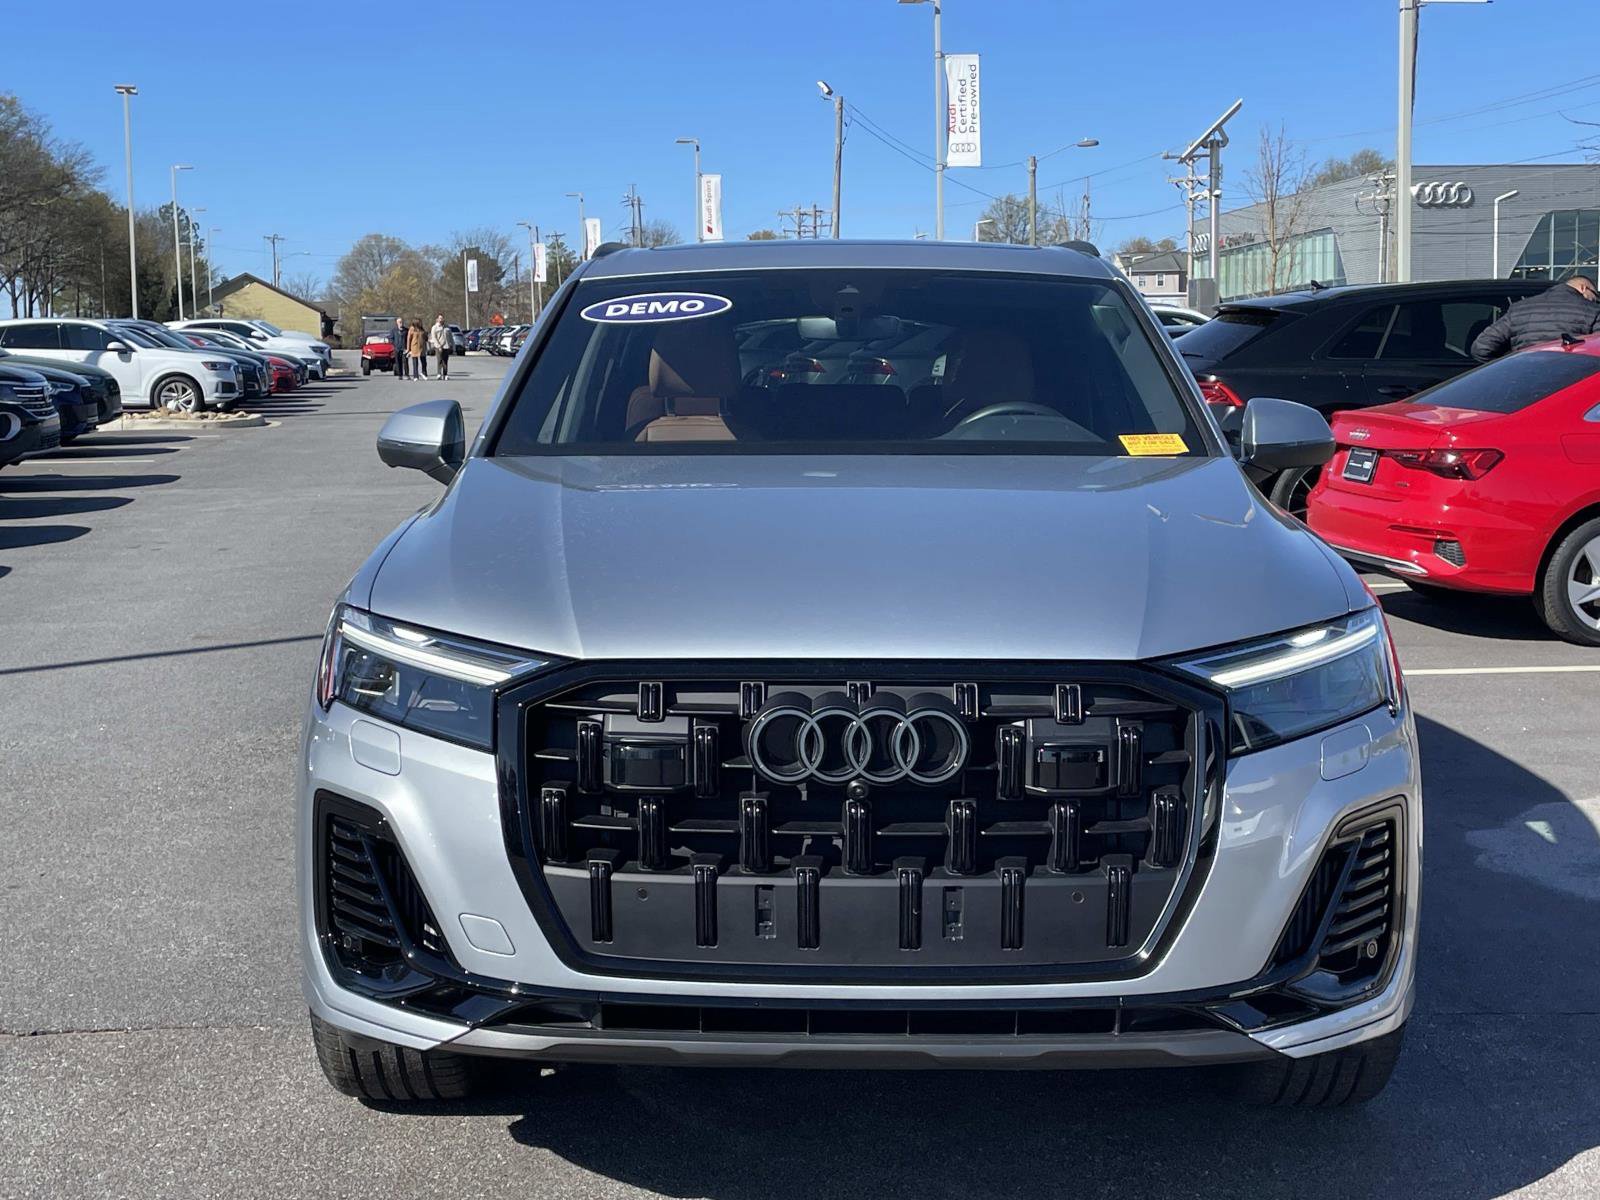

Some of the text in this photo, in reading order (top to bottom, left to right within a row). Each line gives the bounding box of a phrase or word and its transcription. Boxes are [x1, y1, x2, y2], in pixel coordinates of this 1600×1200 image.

[948, 104, 957, 134] Audi
[958, 79, 968, 134] Certified
[968, 64, 977, 133] Pre-owned
[605, 299, 705, 316] DEMO
